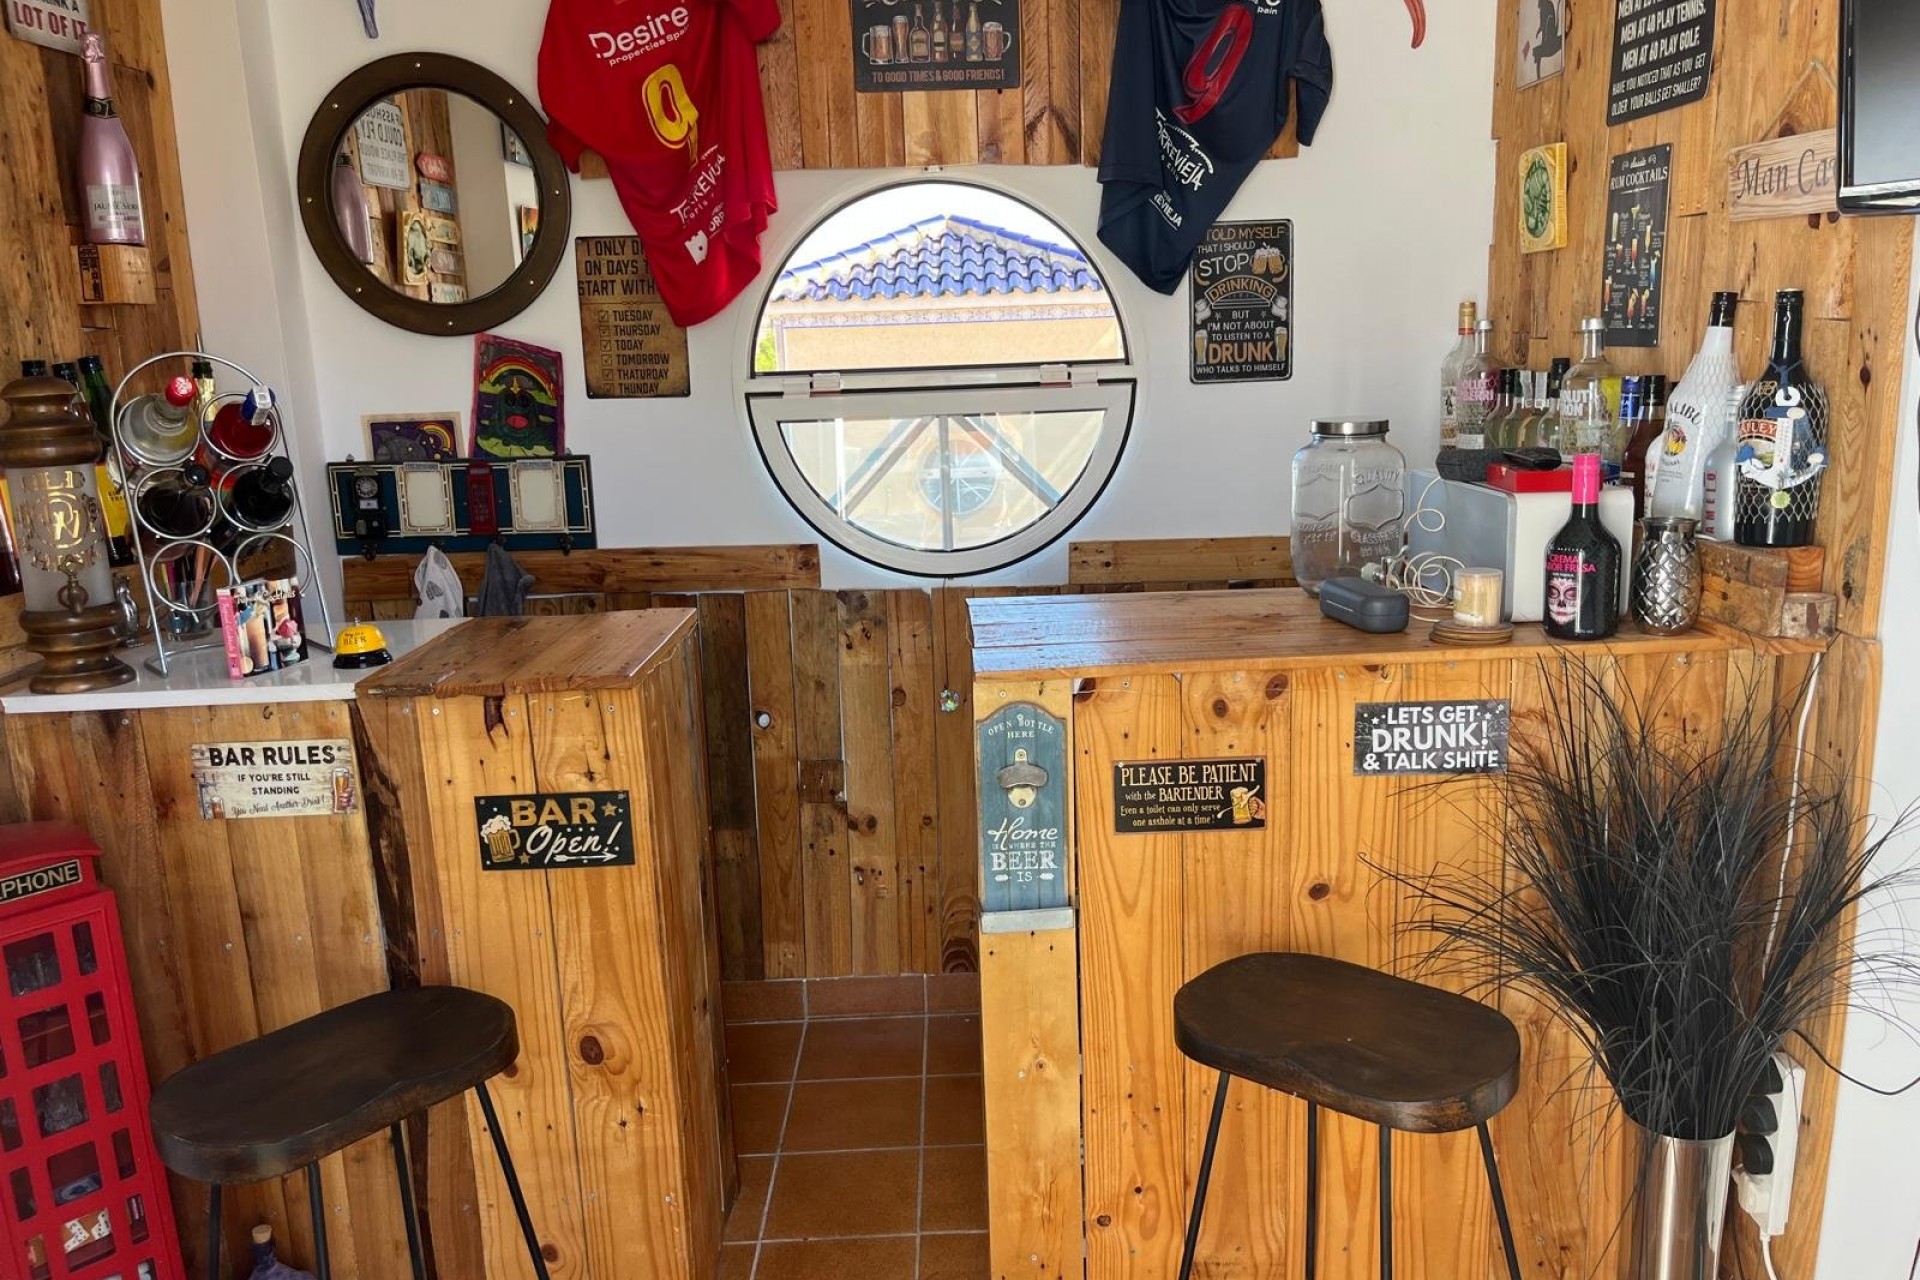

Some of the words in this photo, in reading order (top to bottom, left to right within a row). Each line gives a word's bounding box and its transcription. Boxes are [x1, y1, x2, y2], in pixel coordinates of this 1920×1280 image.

[13, 1, 42, 30] LOT
[48, 12, 68, 37] OF
[1620, 21, 1637, 45] MEN
[1637, 17, 1647, 38] AT
[1647, 13, 1656, 34] 40
[1656, 6, 1675, 31] PLAY
[588, 6, 690, 59] Desire
[608, 38, 666, 67] properties
[1621, 47, 1639, 72] MEN
[1639, 44, 1649, 66] AT
[1659, 33, 1679, 58] PLAY
[1679, 26, 1700, 51] GOLF.
[1172, 3, 1255, 125] 9
[872, 71, 883, 83] TO
[885, 70, 907, 83] GOOD
[908, 70, 935, 82] TIMES
[935, 70, 943, 82] &
[943, 69, 965, 82] GOOD
[1612, 80, 1627, 96] HAVE
[1627, 76, 1637, 91] YOU
[1637, 69, 1659, 87] NOTICED
[1659, 64, 1673, 81] THAT
[1673, 62, 1681, 76] AS
[1681, 57, 1693, 74] YOU
[1694, 52, 1707, 69] GET
[1611, 98, 1628, 116] OLDER
[1630, 93, 1644, 111] YOUR
[1644, 88, 1661, 107] BALLS
[1661, 85, 1673, 101] GET
[1672, 75, 1702, 97] SMALLER?
[1610, 175, 1626, 190] RUM
[1625, 166, 1668, 187] COCKTAILS
[1736, 157, 1790, 199] Man
[1239, 226, 1286, 240] MYSELF
[587, 240, 591, 257] I
[594, 239, 626, 256] ONLY
[1197, 243, 1219, 254] THAT
[1223, 240, 1256, 251] SHOULD
[585, 260, 601, 276] ON
[607, 260, 638, 275] DAYS
[1199, 253, 1250, 277] STOP
[578, 279, 616, 296] START
[621, 279, 655, 295] WITH
[1209, 278, 1273, 300] DRINKING
[613, 310, 653, 322] TUESDAY
[1231, 310, 1251, 319] BUT
[615, 325, 661, 336] THURSDAY
[1207, 322, 1221, 331] I'M
[1223, 321, 1242, 331] NOT
[1244, 320, 1275, 330] ABOUT
[1212, 333, 1223, 341] TO
[1224, 332, 1250, 341] LISTEN
[1253, 331, 1263, 340] TO
[1265, 331, 1270, 339] A
[615, 340, 644, 350] TODAY
[1208, 340, 1274, 364] DRUNK
[617, 354, 670, 365] TOMORROW
[1196, 365, 1215, 374] WHO
[1217, 364, 1240, 373] TALKS
[1242, 364, 1252, 372] TO
[1253, 362, 1286, 372] HIMSELF
[617, 368, 669, 380] THATURDAY
[619, 383, 660, 394] THUNDAY
[1548, 554, 1579, 564] CREMA
[1387, 706, 1433, 725] LETS
[1439, 705, 1478, 723] GET
[988, 720, 1012, 736] OPEN
[1018, 718, 1055, 735] BOTTLE
[1007, 730, 1035, 738] HERE
[1372, 720, 1489, 753] DRUNK!
[208, 747, 257, 766] BAR
[263, 745, 336, 766] RULES
[1362, 753, 1380, 770] &
[1384, 752, 1437, 770] TALK
[1443, 750, 1499, 768] SHITE
[238, 773, 246, 782] IF
[249, 773, 283, 782] YOU'RE
[286, 772, 311, 781] STILL
[1121, 765, 1175, 786] PLEASE
[1178, 765, 1198, 784] BE
[1202, 762, 1257, 783] PATIENT
[252, 786, 300, 795] STANDING
[1125, 791, 1141, 801] with
[1144, 789, 1156, 800] the
[1159, 785, 1224, 802] BARTENDER
[231, 806, 247, 817] You
[250, 802, 269, 815] Need
[271, 800, 299, 812] Another
[510, 797, 597, 827] BAR
[1120, 805, 1137, 816] Even
[1146, 803, 1165, 815] toilet
[1183, 802, 1198, 814] only
[1201, 803, 1221, 811] serve
[1132, 819, 1145, 827] one
[1148, 816, 1176, 826] asshole
[1177, 817, 1185, 826] at
[987, 816, 1059, 851] Home
[526, 821, 622, 865] Open!
[1009, 841, 1036, 849] WHERE
[1039, 841, 1056, 849] THE
[990, 849, 1058, 871] BEER
[0, 863, 79, 899] PHONE
[1016, 871, 1033, 882] IS
